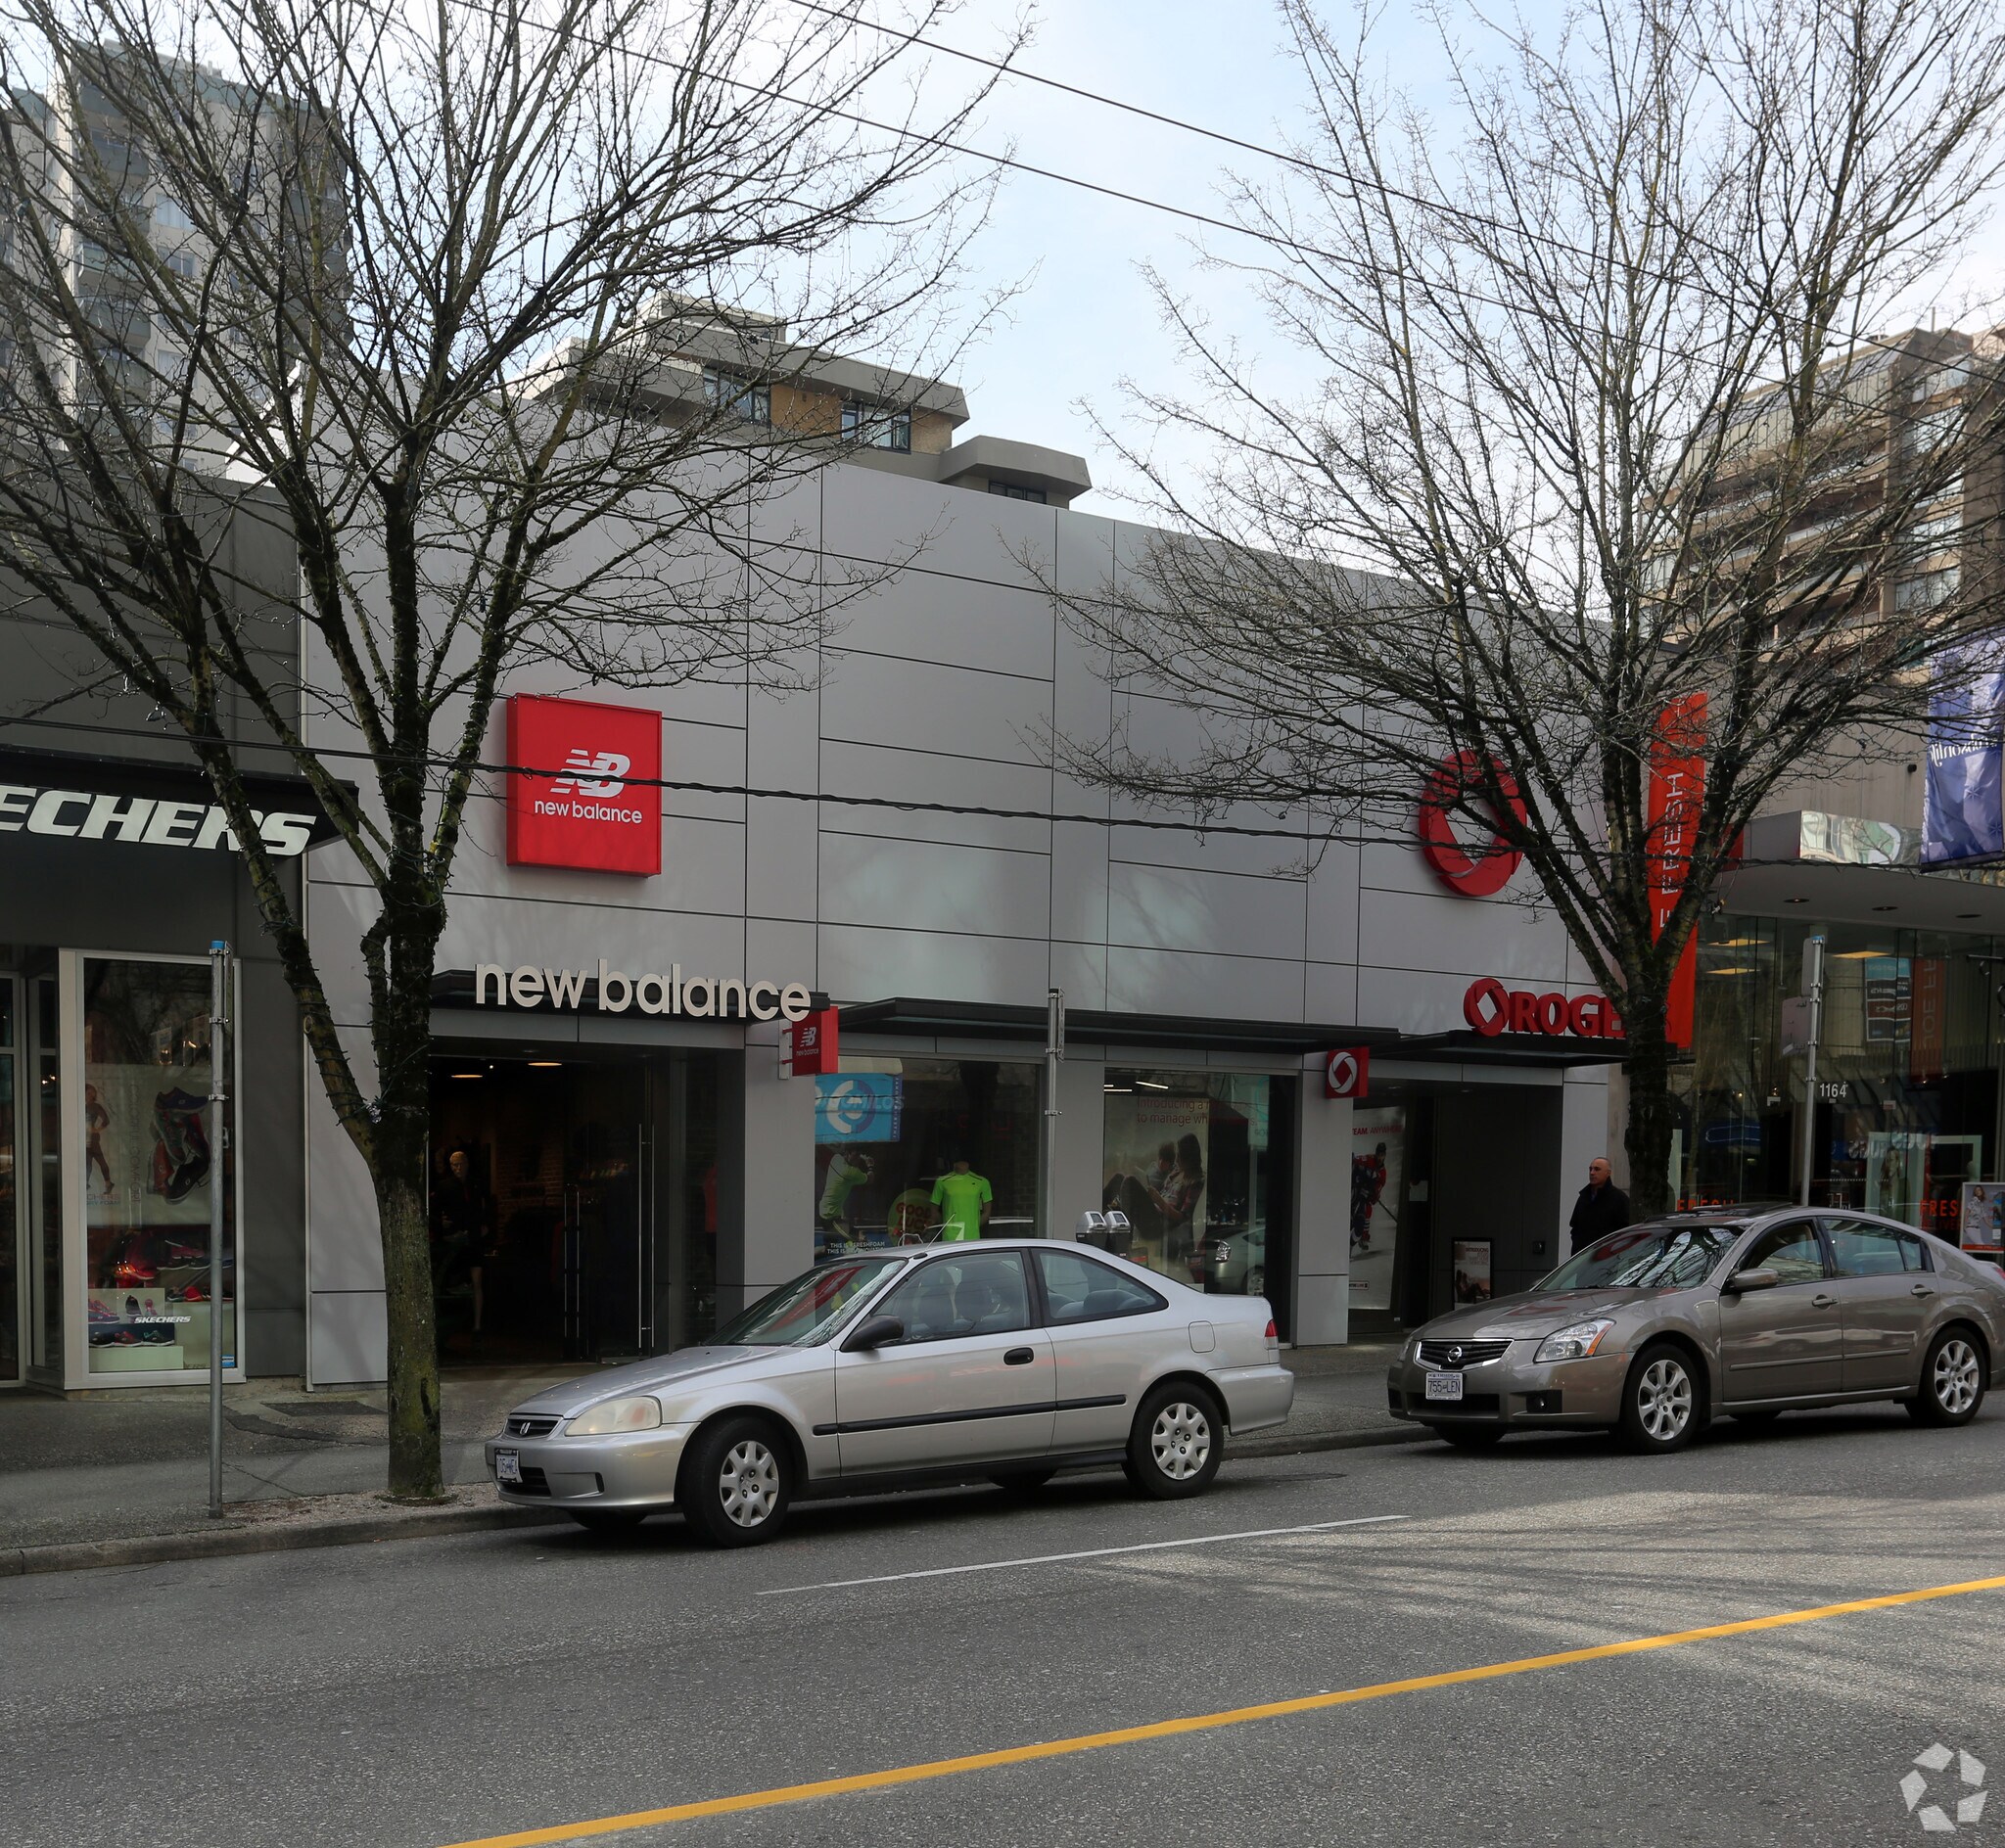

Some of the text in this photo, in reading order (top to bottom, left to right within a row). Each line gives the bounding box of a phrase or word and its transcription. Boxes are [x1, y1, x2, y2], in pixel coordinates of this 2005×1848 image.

[535, 801, 642, 824] new balance
[1661, 772, 1684, 895] FRESH
[475, 958, 812, 1022] new balance
[1509, 991, 1627, 1038] ROGE
[1820, 1082, 1848, 1097] 1164
[1137, 1097, 1195, 1112] Introducing
[1137, 1113, 1147, 1124] to
[1150, 1114, 1191, 1127] manage
[1920, 1199, 1959, 1217] FRES
